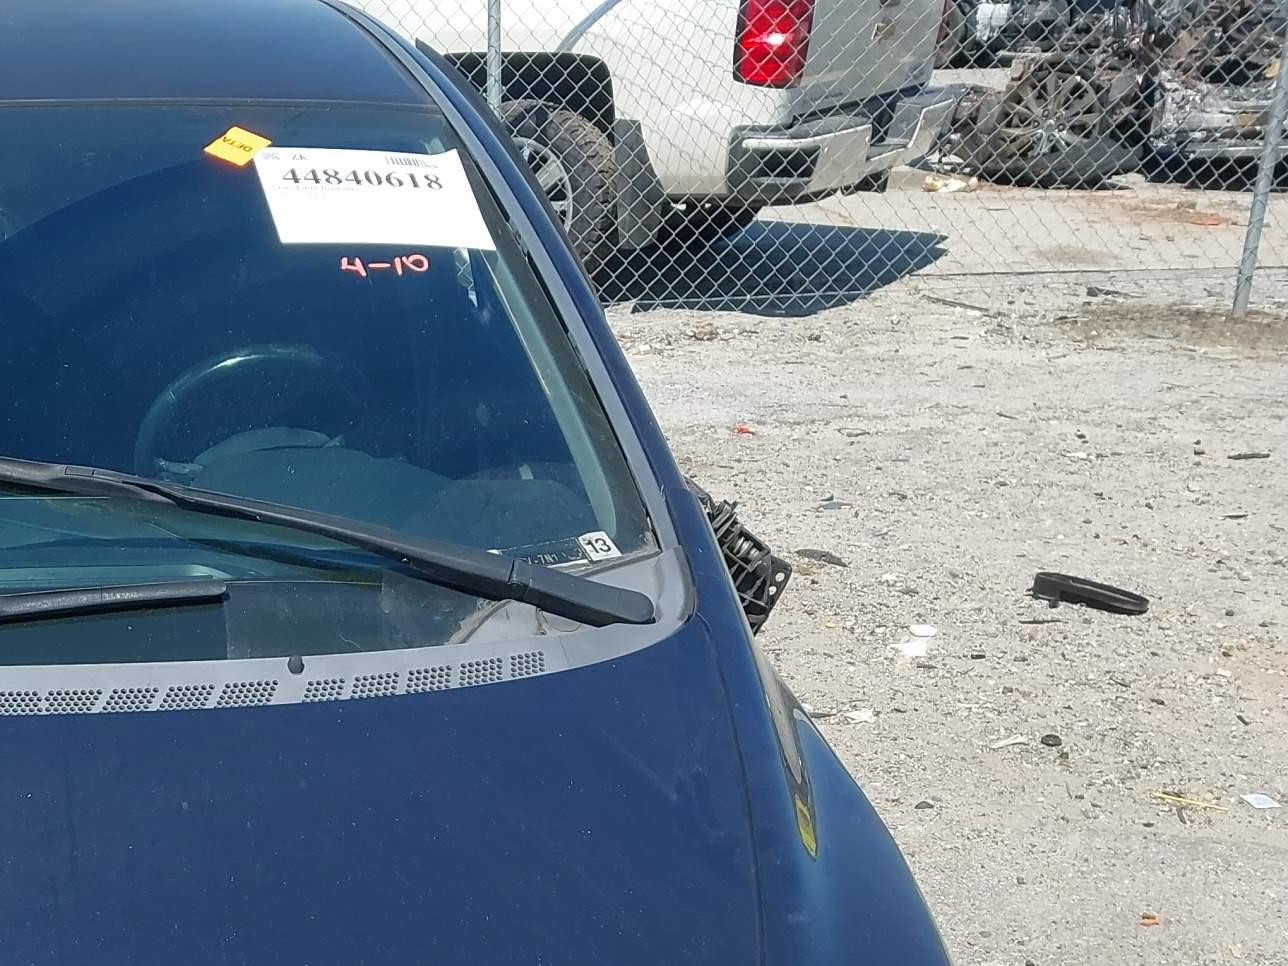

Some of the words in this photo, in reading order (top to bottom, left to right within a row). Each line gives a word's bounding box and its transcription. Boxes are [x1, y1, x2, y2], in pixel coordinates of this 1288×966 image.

[282, 167, 444, 191] 44840618
[340, 253, 430, 278] 4-10
[585, 537, 612, 554] 13
